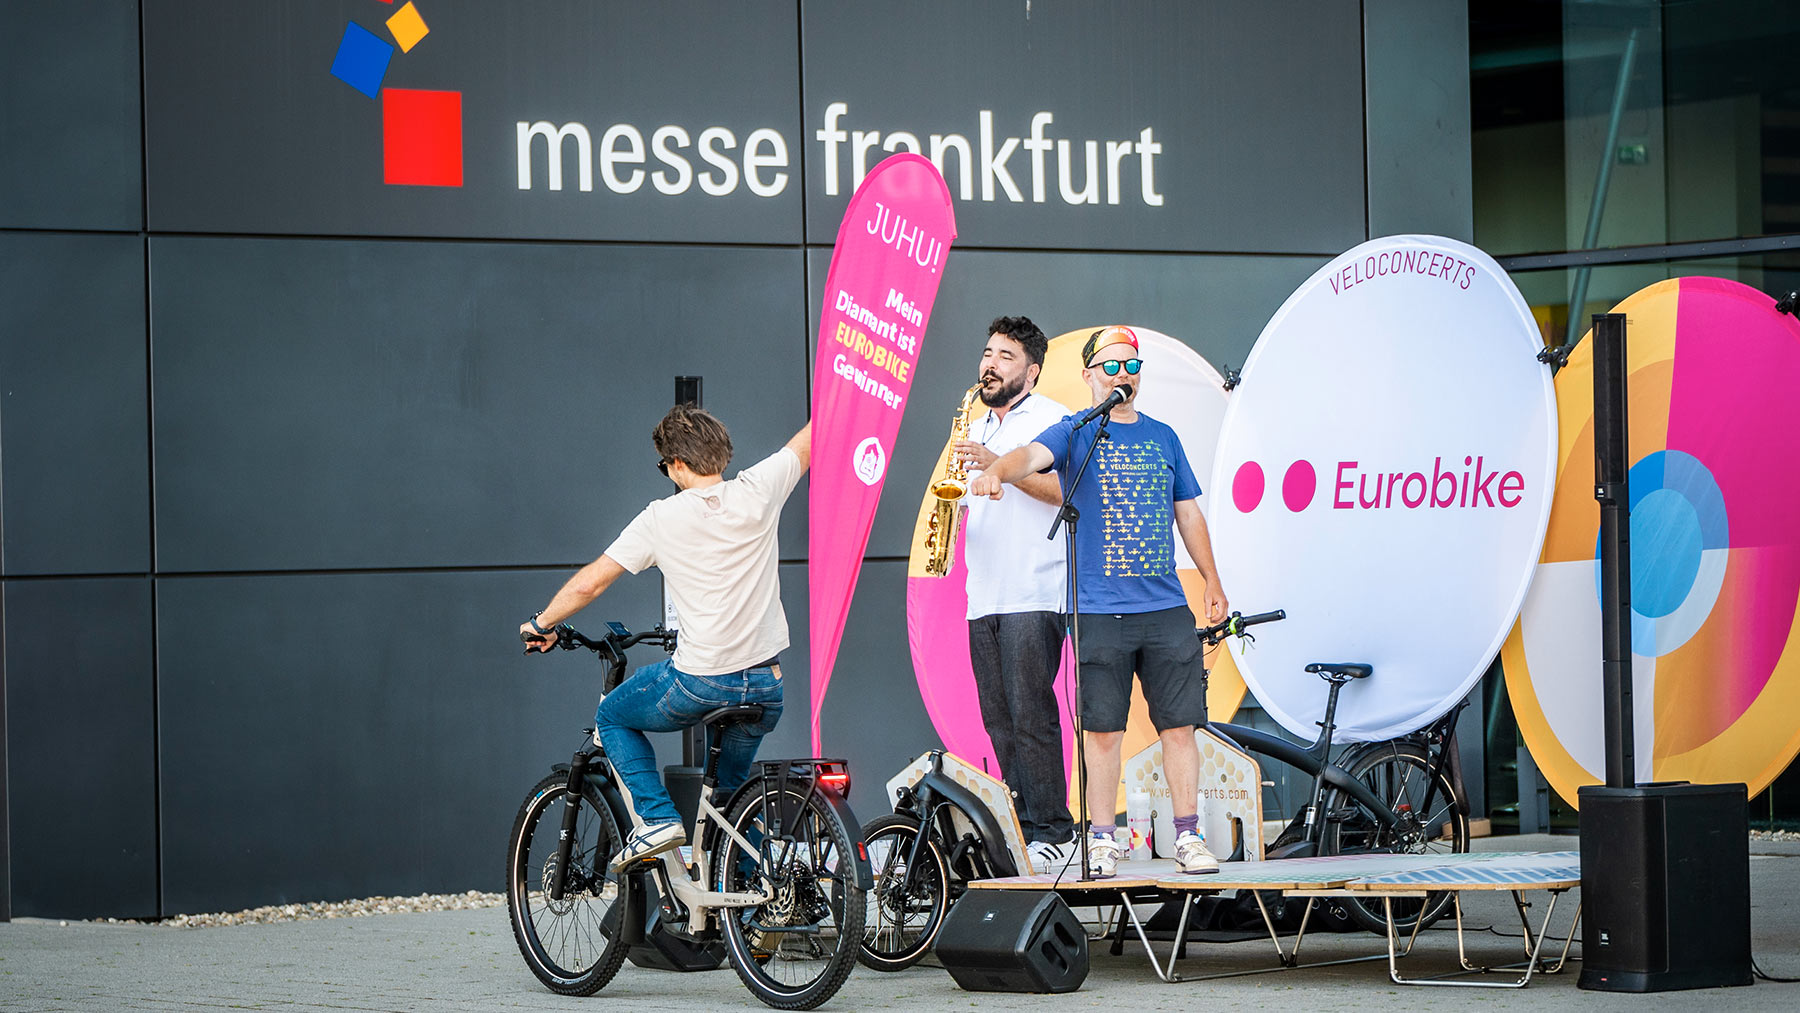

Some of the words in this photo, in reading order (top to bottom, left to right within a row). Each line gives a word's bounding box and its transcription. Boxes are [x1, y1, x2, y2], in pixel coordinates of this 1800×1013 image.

[516, 120, 790, 197] messe
[866, 202, 942, 274] JUHU!
[1329, 250, 1476, 296] VELOCONCERTS
[835, 289, 898, 342] Diamant
[897, 327, 917, 356] ist
[885, 287, 923, 327] Mein
[835, 321, 910, 384] EUROBIKE
[833, 353, 903, 410] Gewinner
[1110, 463, 1158, 471] VELOCONCERTS
[1333, 455, 1525, 510] Eurobike
